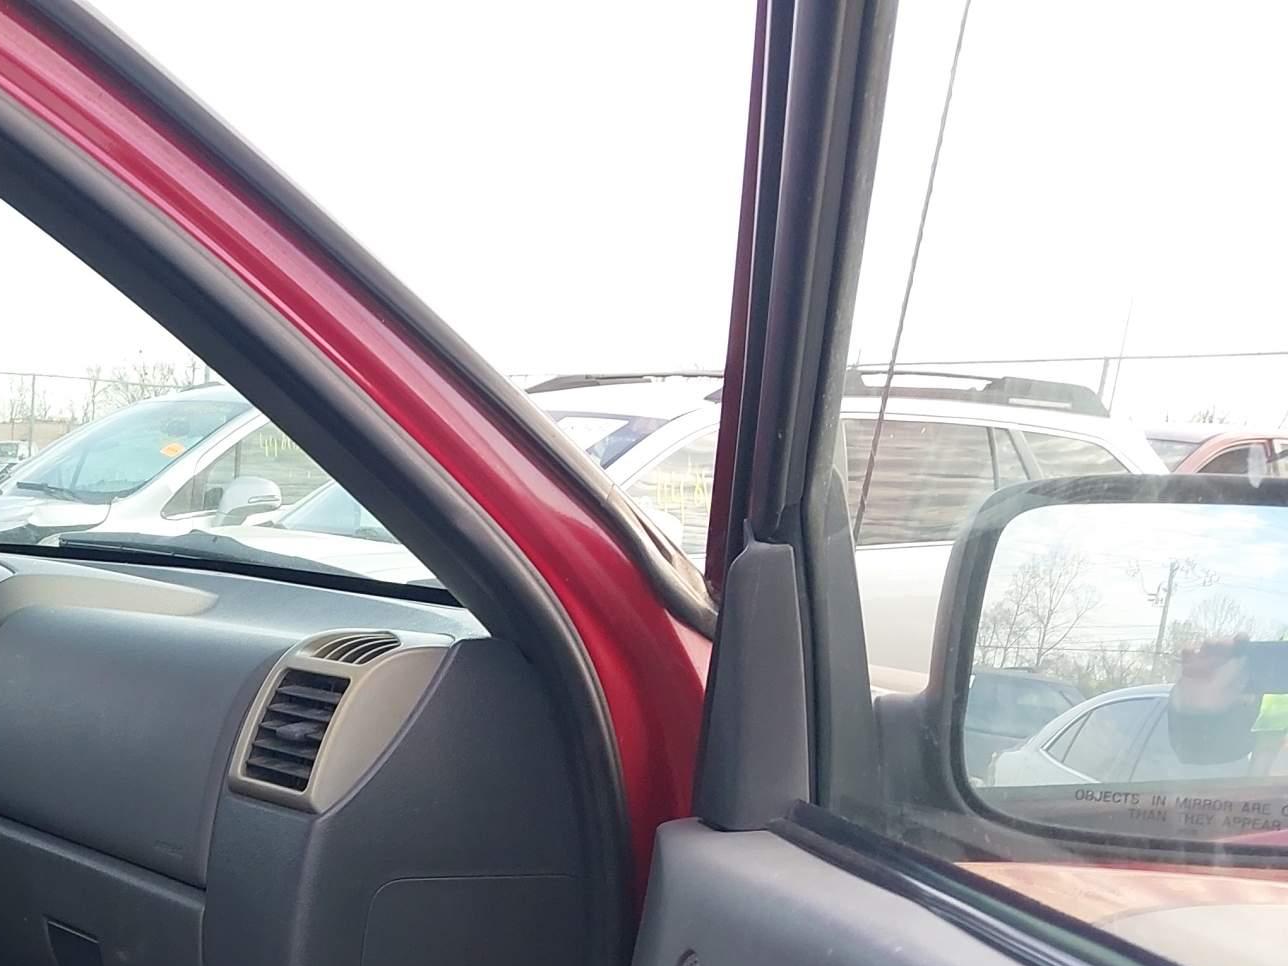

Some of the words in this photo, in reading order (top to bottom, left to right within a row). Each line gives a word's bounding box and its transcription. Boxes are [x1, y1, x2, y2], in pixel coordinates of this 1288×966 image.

[1075, 789, 1140, 805] OBJECTS
[1151, 795, 1167, 807] IN
[1176, 796, 1233, 813] MIRROR
[1241, 801, 1272, 815] ARE
[1129, 808, 1167, 823] THAN
[1223, 816, 1281, 831] APPEAR
